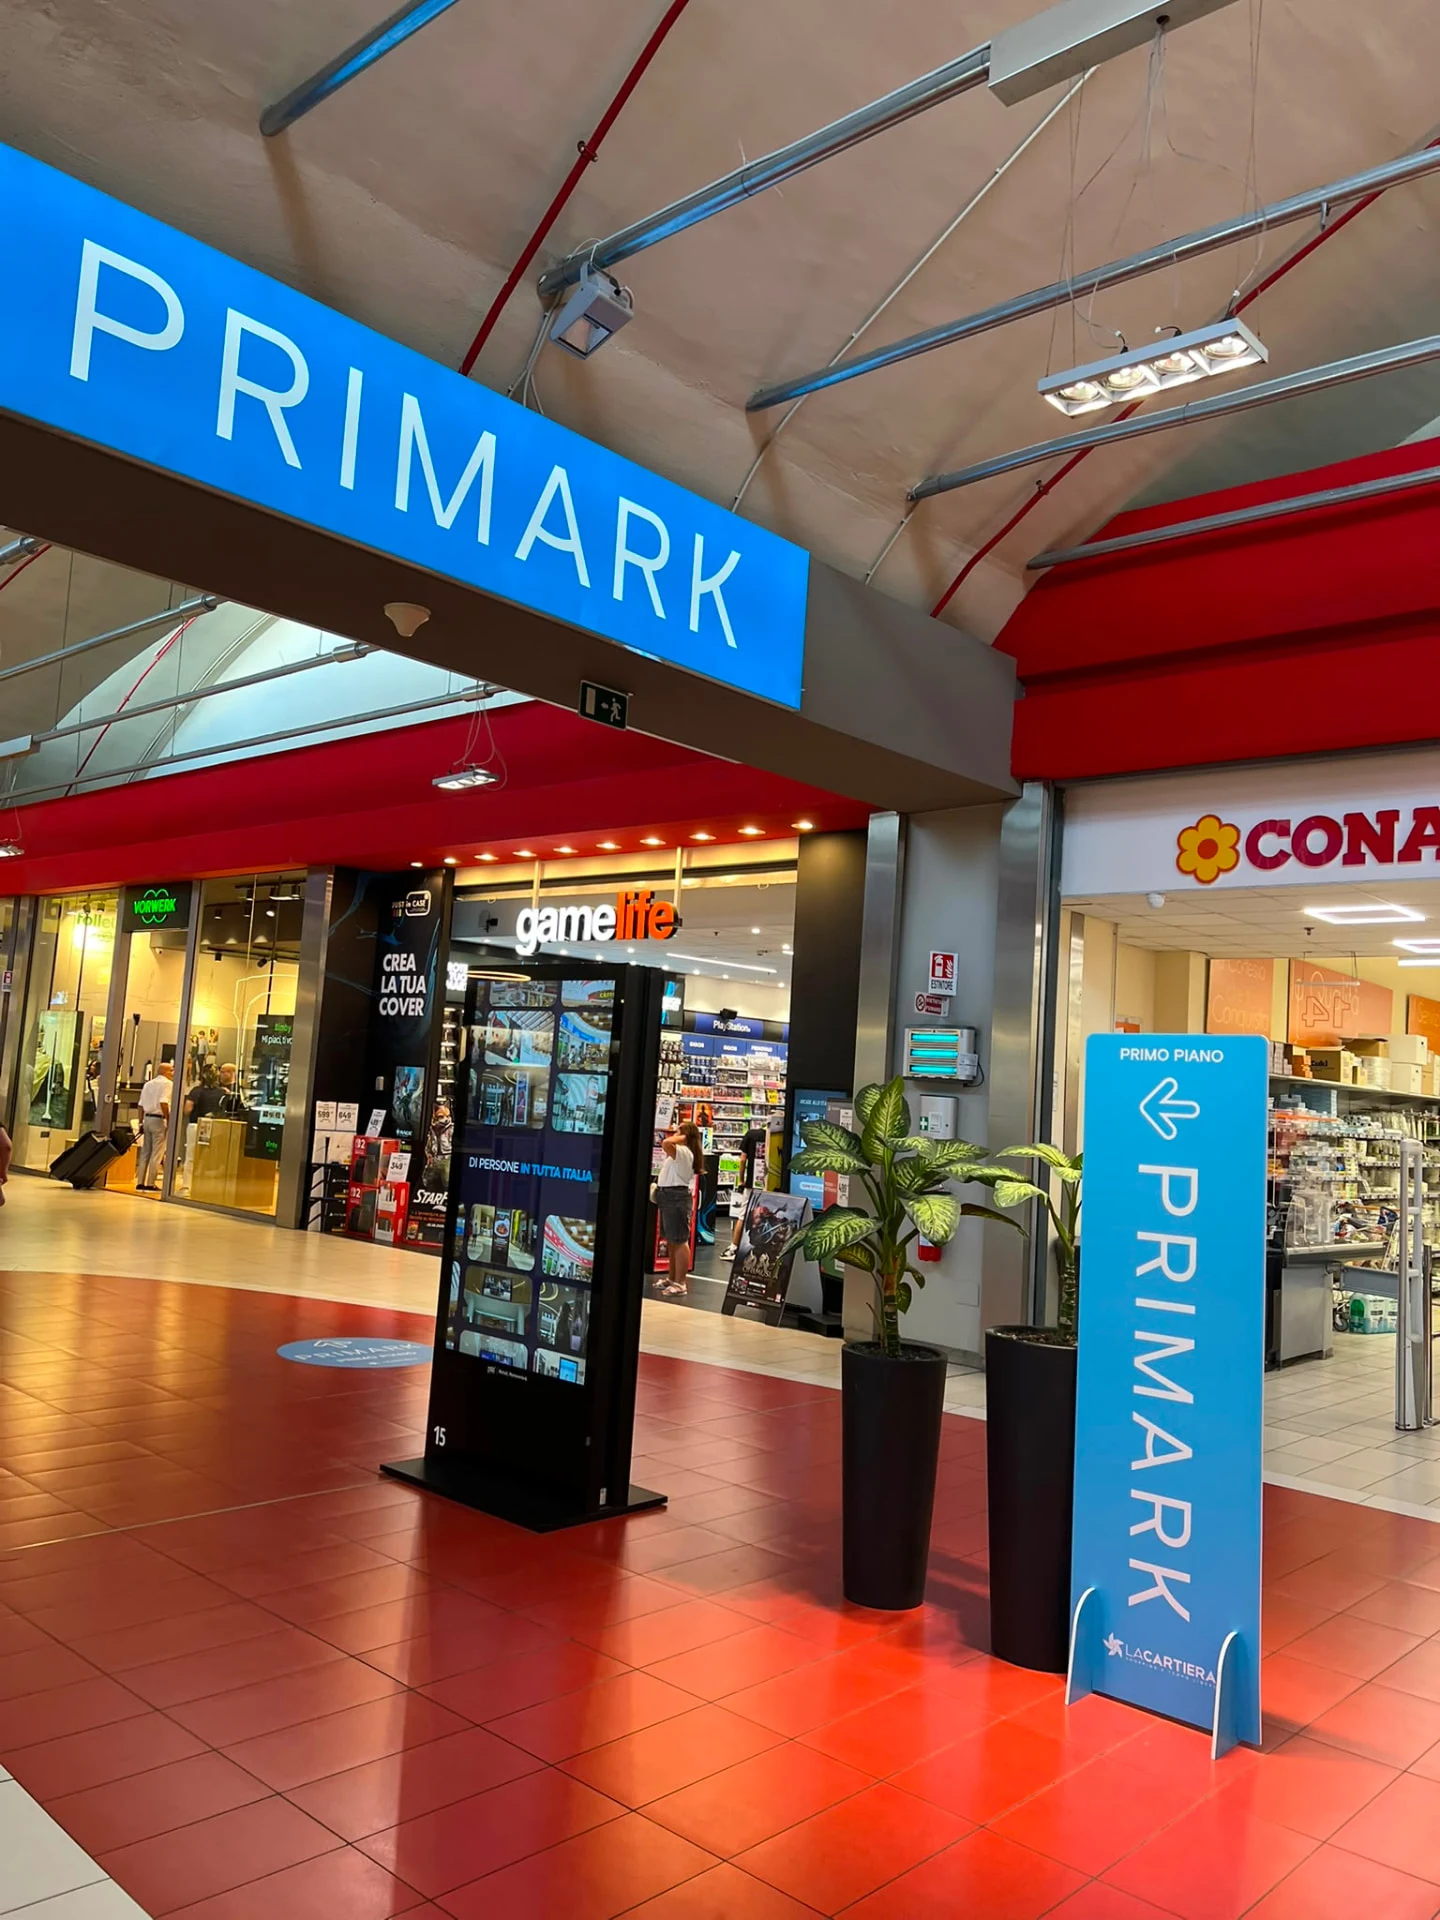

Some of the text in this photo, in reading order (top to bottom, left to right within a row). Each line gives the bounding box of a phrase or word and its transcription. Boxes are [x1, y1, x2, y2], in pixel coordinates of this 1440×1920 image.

[70, 238, 741, 649] PRIMARK
[1246, 806, 1440, 870] CONA
[134, 898, 176, 914] VORWERK
[412, 899, 426, 908] CASE
[515, 890, 676, 956] gamelife
[383, 953, 416, 971] CREA
[381, 975, 397, 993] LA
[400, 975, 427, 994] TUA
[931, 980, 953, 990] ESTINTORE
[379, 997, 424, 1016] COVER
[1120, 1047, 1224, 1063] PRIMO PIANO
[469, 1156, 593, 1182] DI PERSONE IN TUTTA ITALIA
[1127, 1164, 1199, 1623] PRIMARK
[433, 1425, 446, 1447] 15
[1125, 1644, 1217, 1684] LACARTIERA
